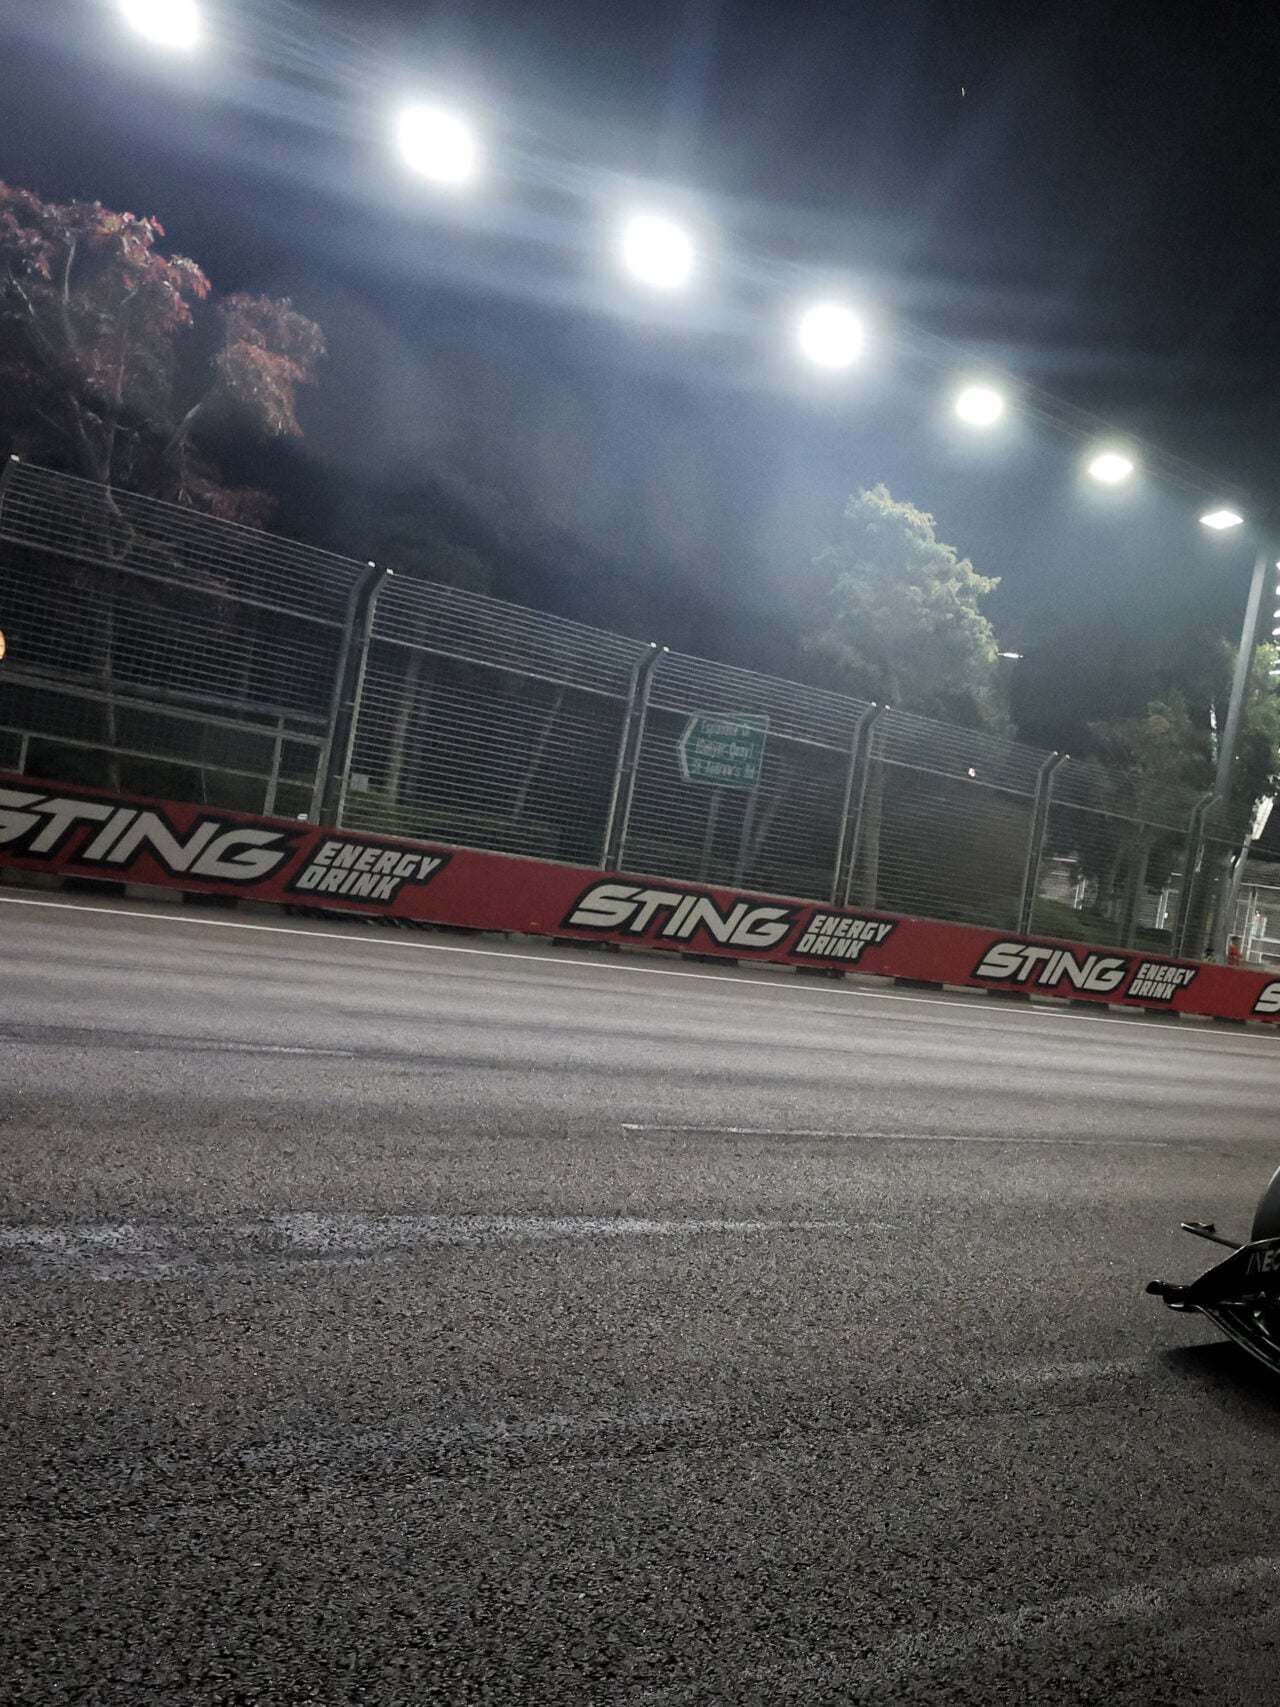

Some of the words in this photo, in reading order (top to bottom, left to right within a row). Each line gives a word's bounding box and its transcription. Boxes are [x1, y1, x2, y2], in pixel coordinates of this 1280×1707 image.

[310, 841, 442, 884] ENERGY
[296, 866, 401, 900] DRINK
[570, 884, 790, 947] STING
[807, 914, 893, 942] ENERGY
[796, 934, 865, 959] DRINK
[976, 943, 1125, 991] STING
[1137, 963, 1196, 986] ENERGY
[1128, 980, 1175, 1000] DRINK
